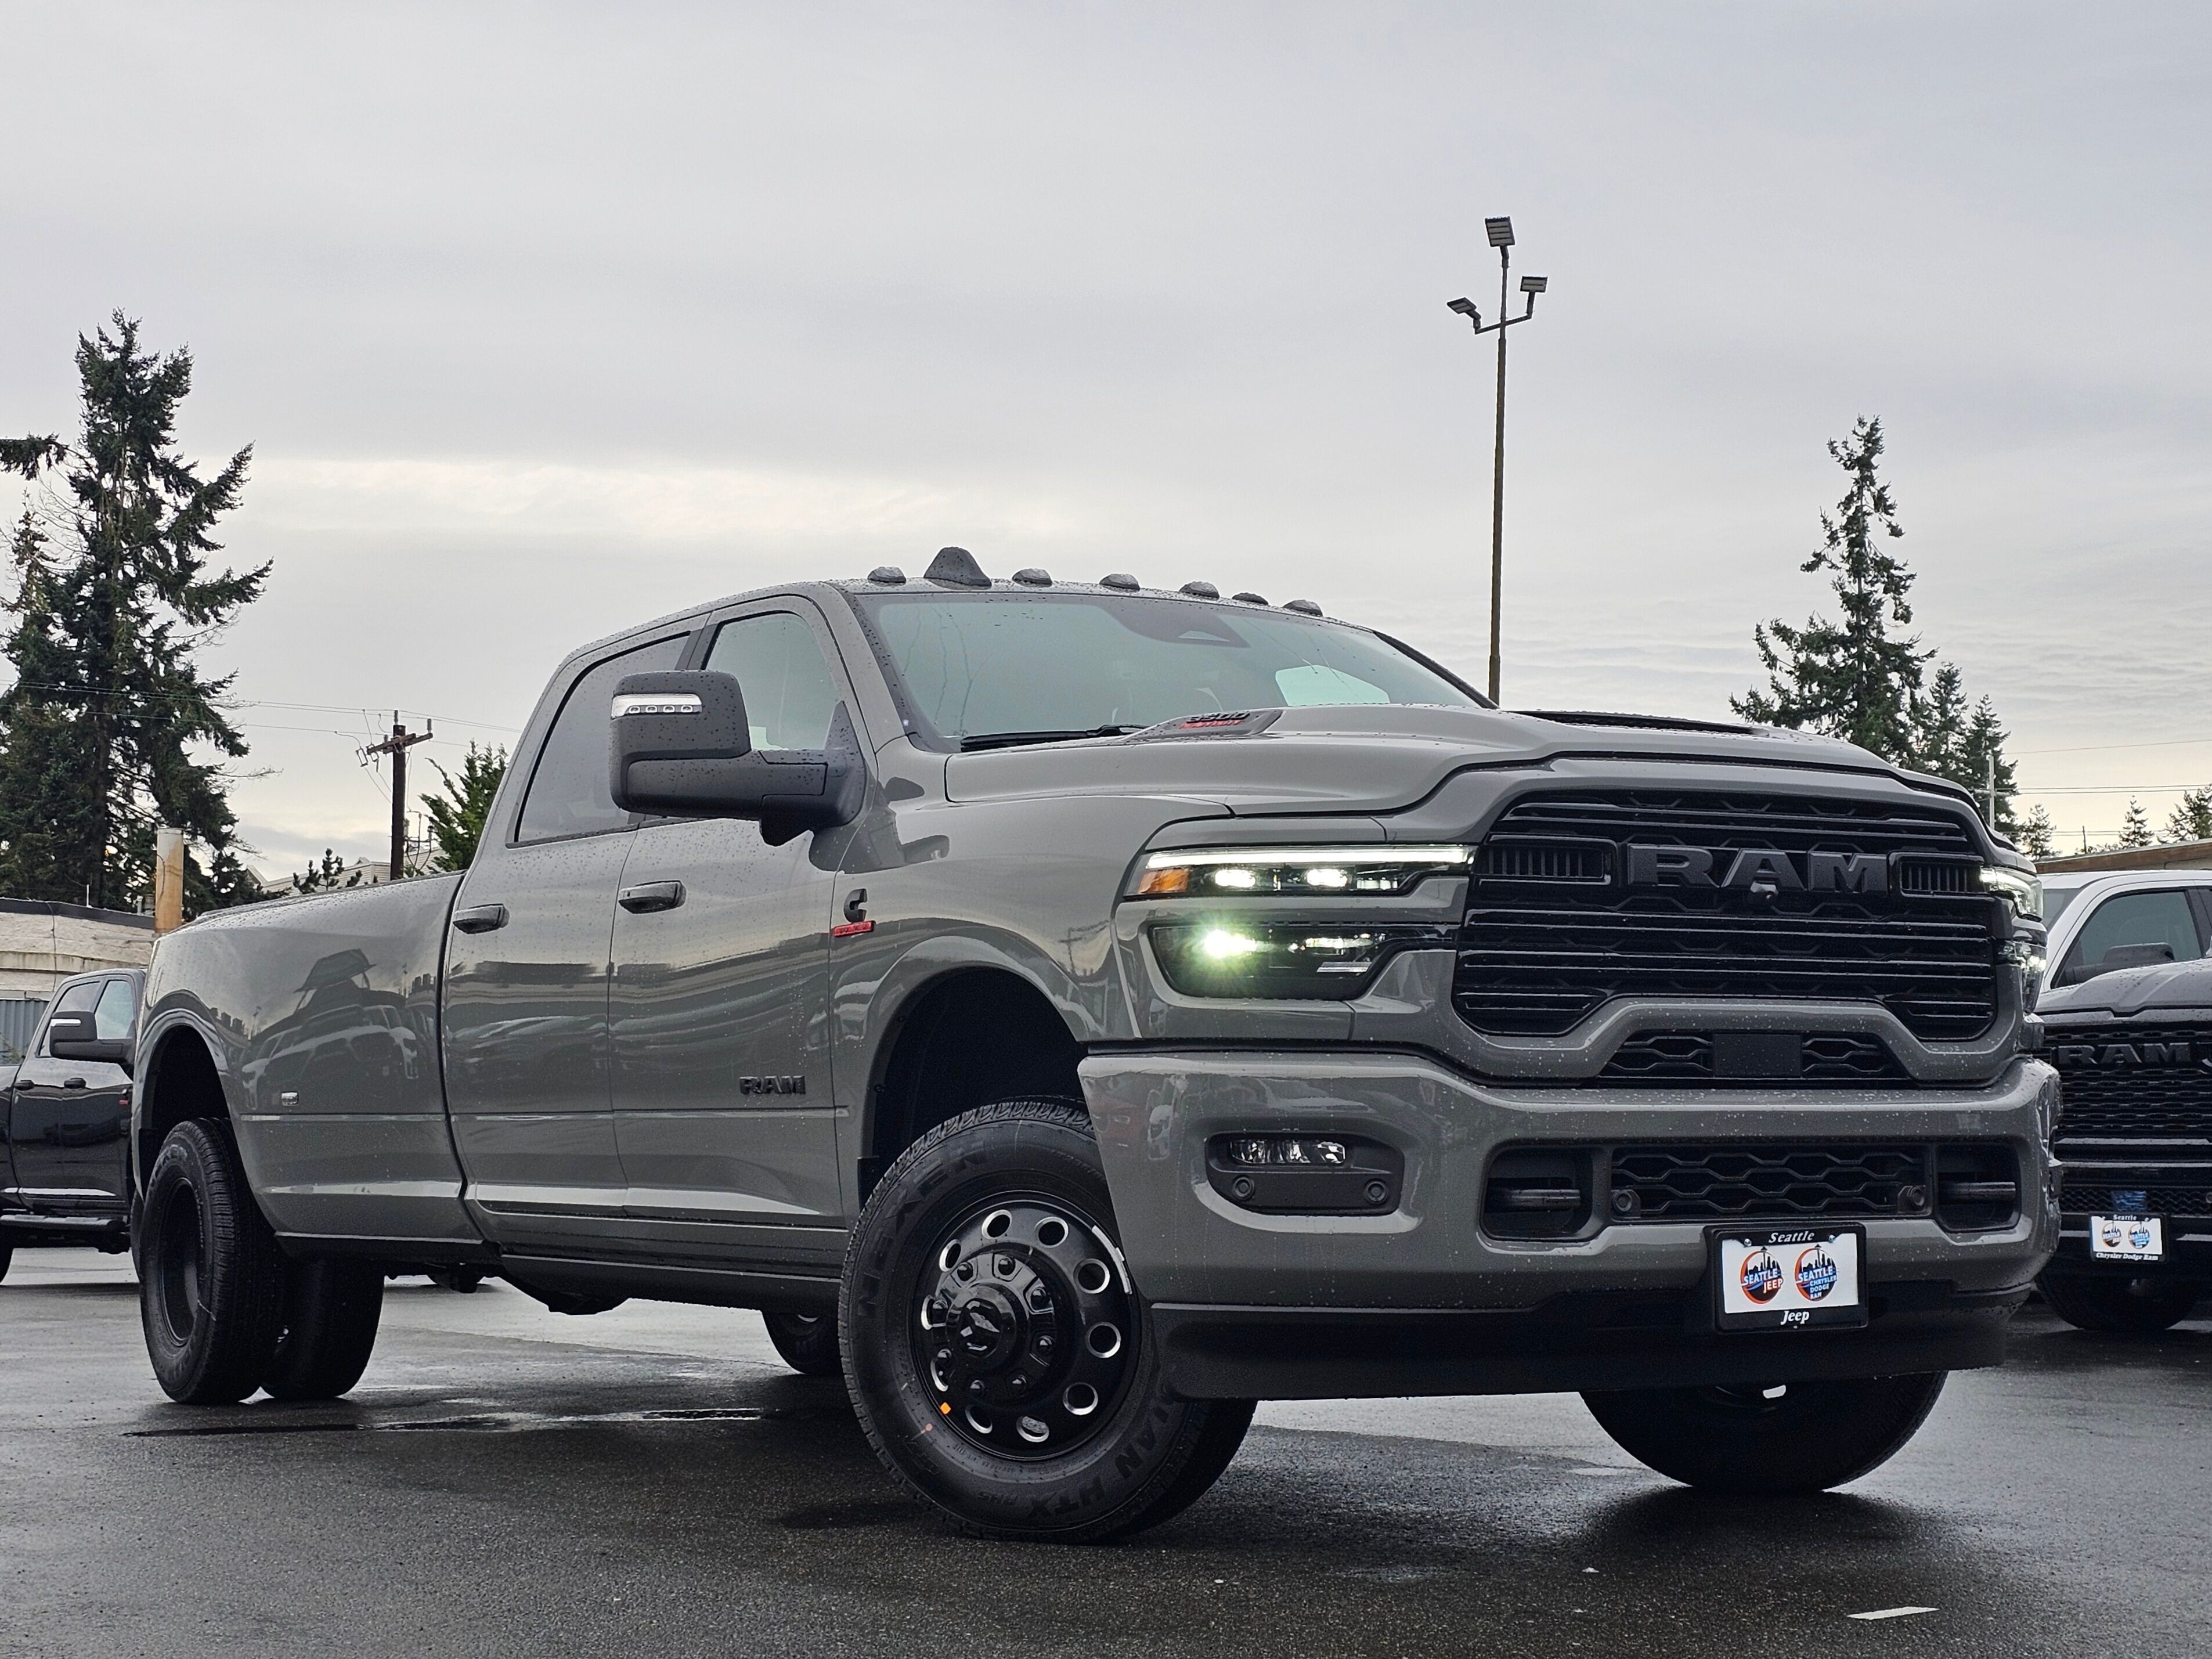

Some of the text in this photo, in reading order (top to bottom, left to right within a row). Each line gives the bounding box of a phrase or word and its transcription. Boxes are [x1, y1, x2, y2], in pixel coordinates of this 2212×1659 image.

[1186, 710, 1250, 723] 3500
[1627, 843, 1891, 894] RAM
[2058, 1043, 2191, 1064] RAM
[739, 1075, 806, 1095] RAM
[858, 1139, 993, 1316] NEXEN
[1769, 1231, 1814, 1243] Seattle
[1744, 1268, 1778, 1284] SEATTLE
[1798, 1265, 1833, 1282] SEATTLE
[1810, 1275, 1837, 1286] CHRYSLER
[1763, 1278, 1783, 1294] JEEP
[1810, 1283, 1829, 1293] DODGE
[1810, 1292, 1822, 1300] RAM
[1780, 1310, 1810, 1325] Jeep
